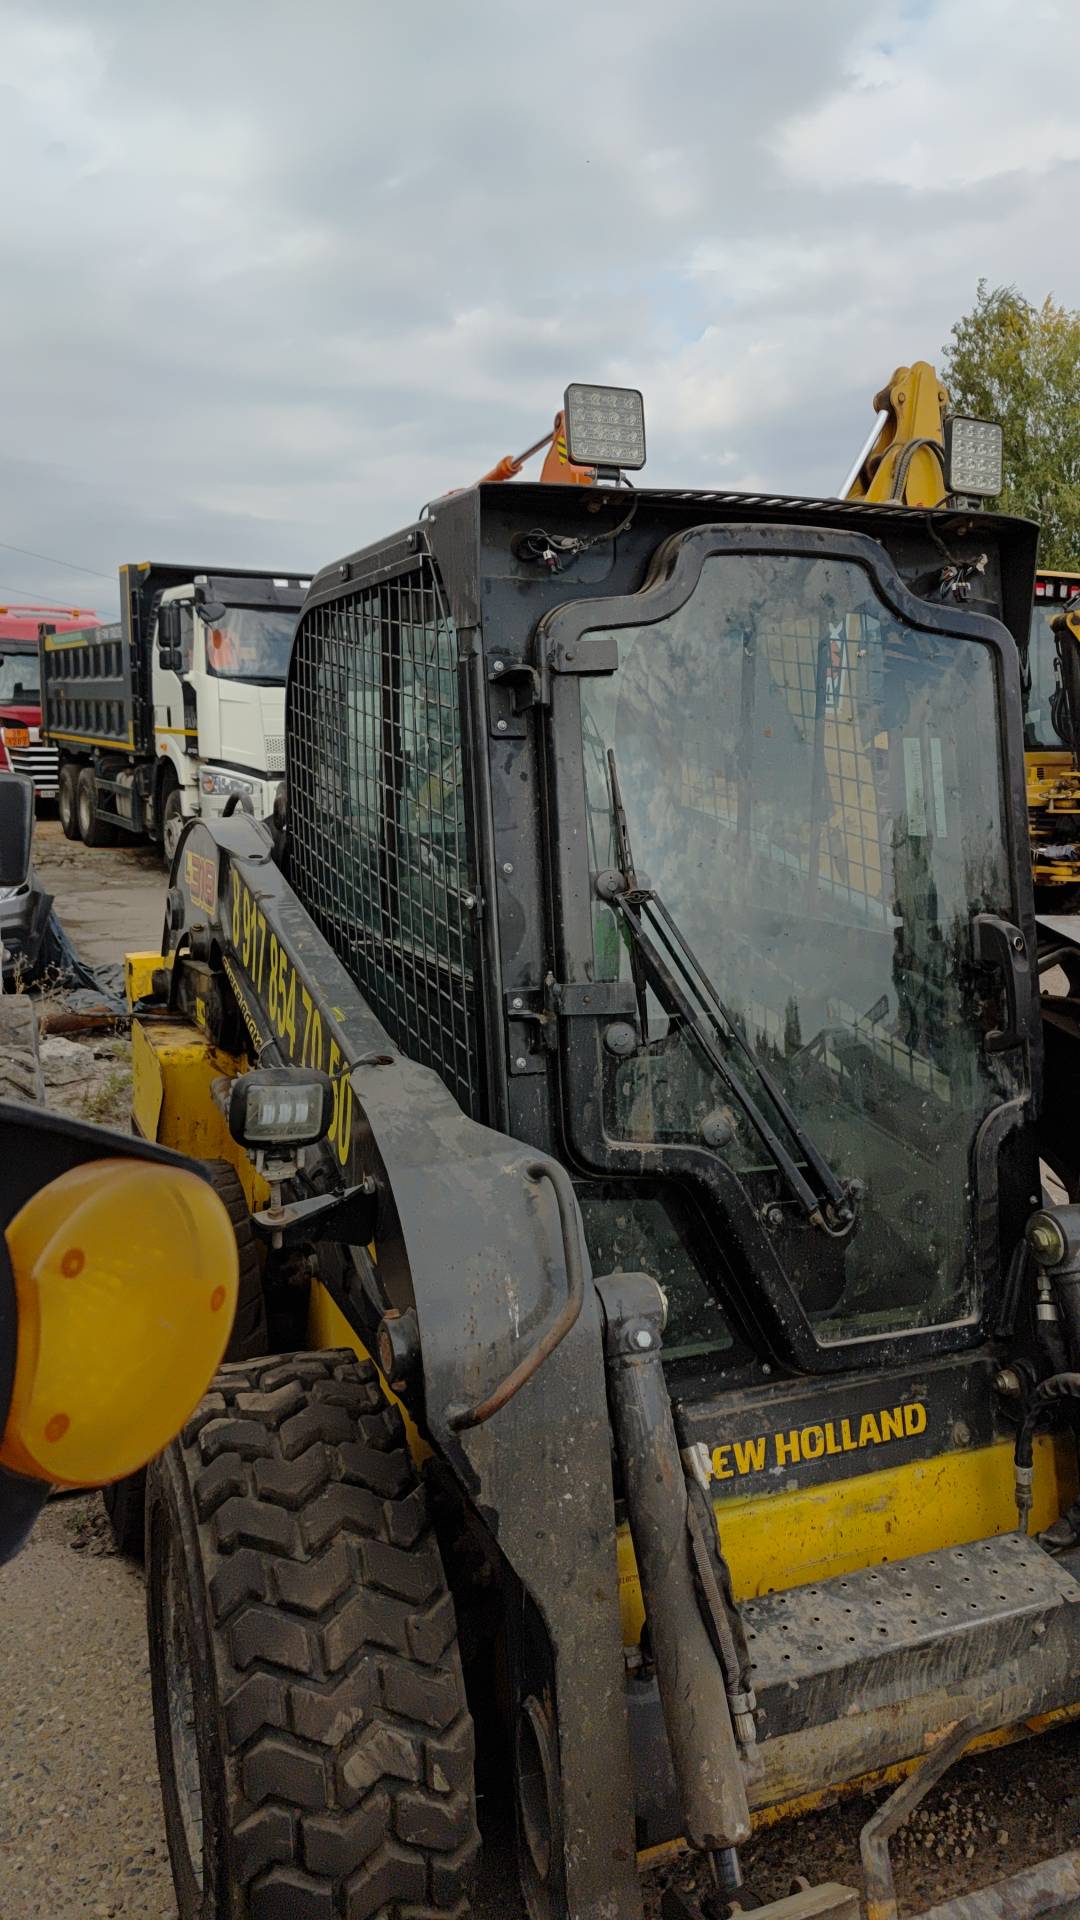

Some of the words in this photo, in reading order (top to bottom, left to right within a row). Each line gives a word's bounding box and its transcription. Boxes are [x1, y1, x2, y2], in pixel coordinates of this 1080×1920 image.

[232, 867, 240, 949] 8
[242, 886, 267, 993] 917
[269, 932, 296, 1058] 854
[328, 1037, 352, 1166] 50
[707, 1437, 766, 1481] EW
[775, 1402, 928, 1466] HOLLAND
